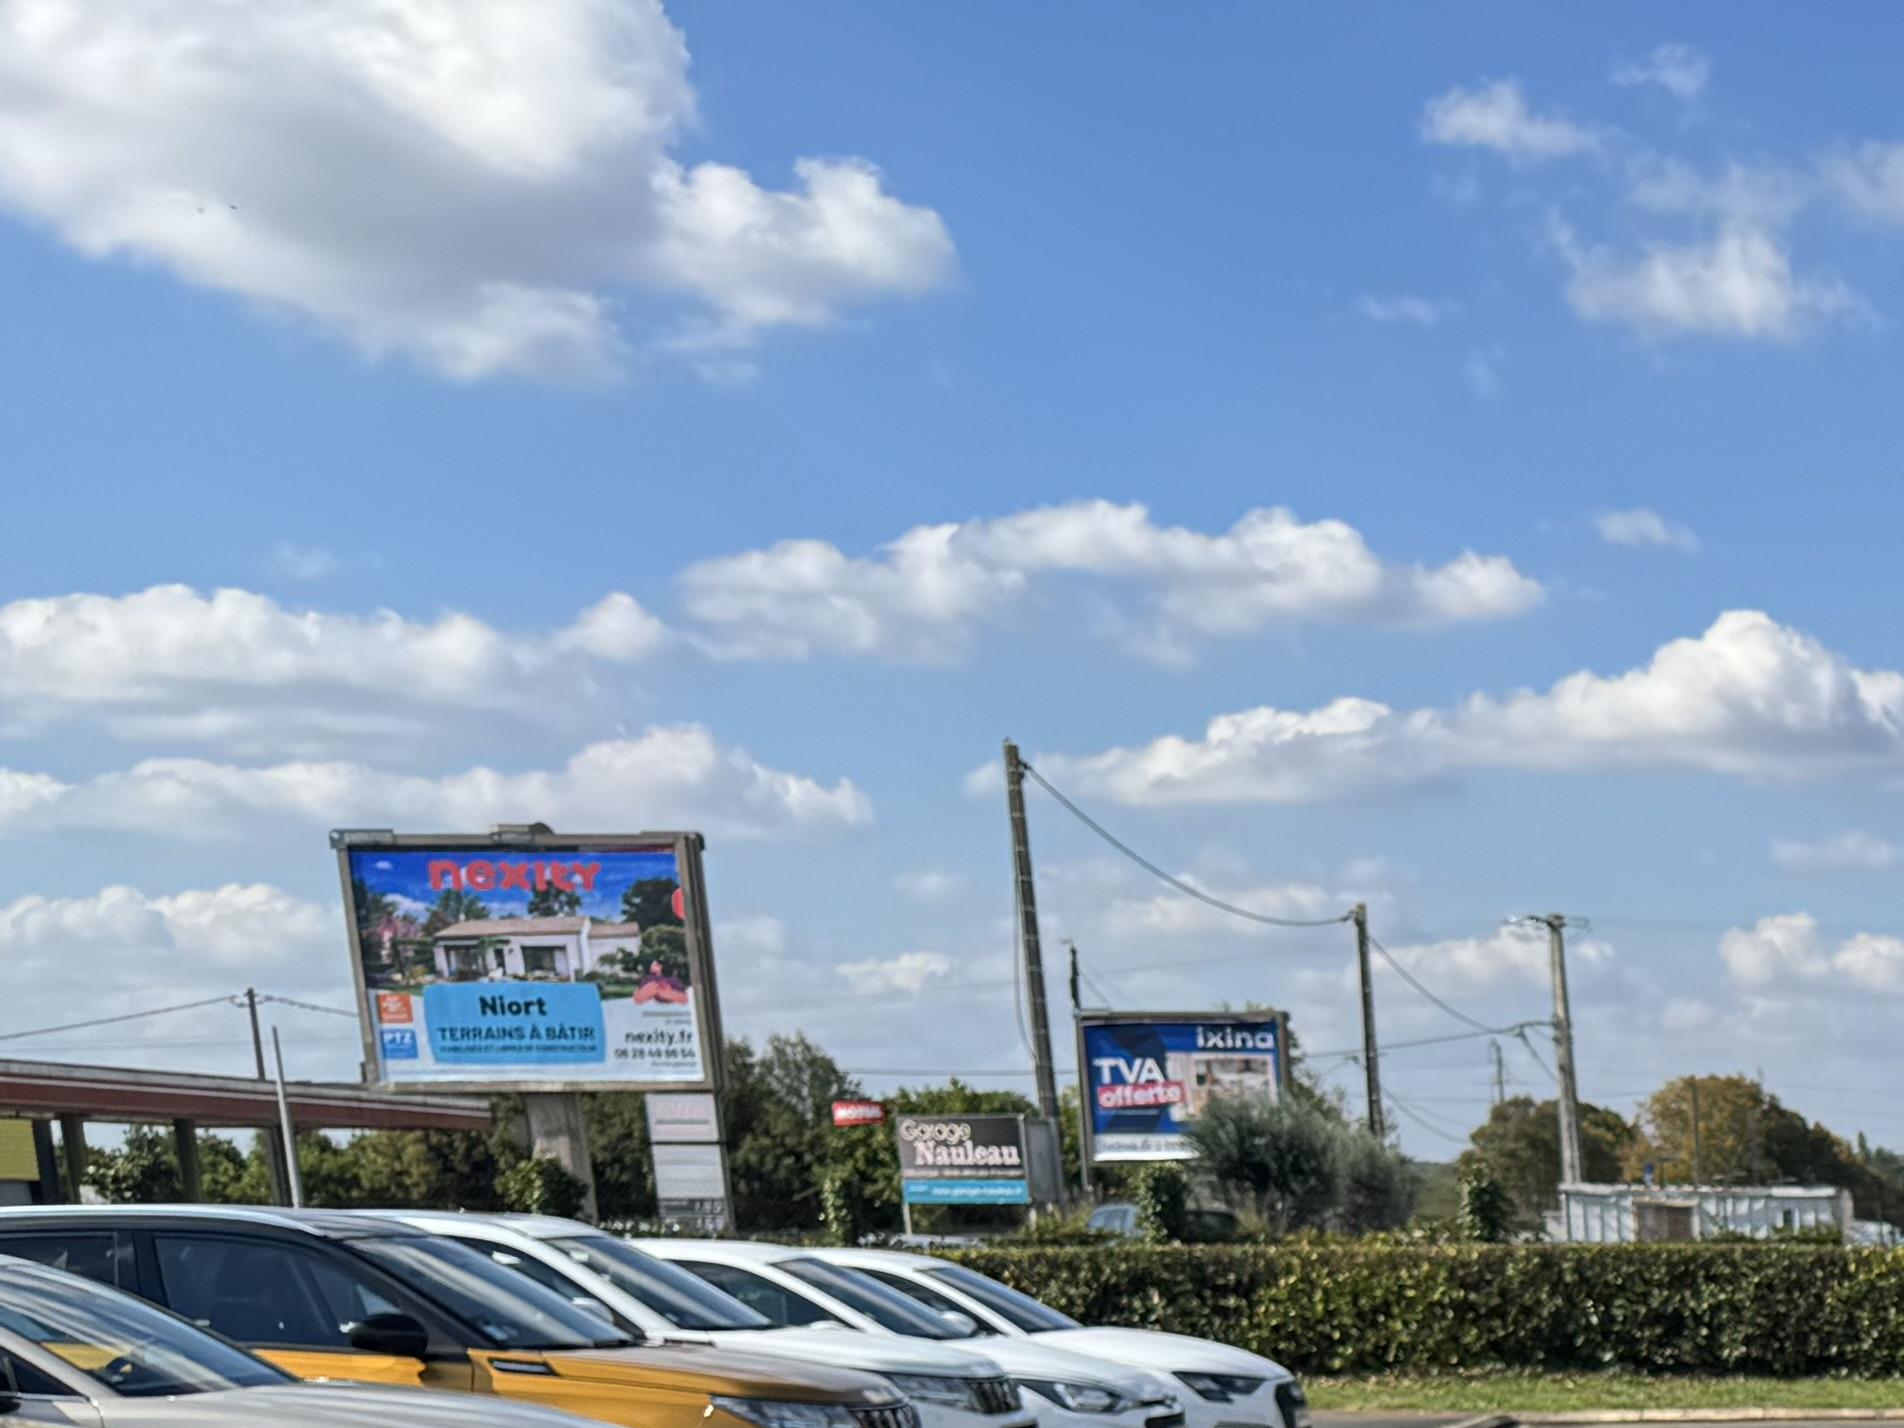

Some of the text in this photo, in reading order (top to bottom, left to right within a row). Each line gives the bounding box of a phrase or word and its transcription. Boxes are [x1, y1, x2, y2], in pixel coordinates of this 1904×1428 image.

[428, 859, 601, 891] nexity
[479, 996, 548, 1016] Niort
[438, 1025, 526, 1041] TERRAINS
[530, 1022, 542, 1040] À
[1196, 1026, 1275, 1049] ixina
[1093, 1058, 1165, 1084] TVA
[913, 1140, 1021, 1166] Nauleau
